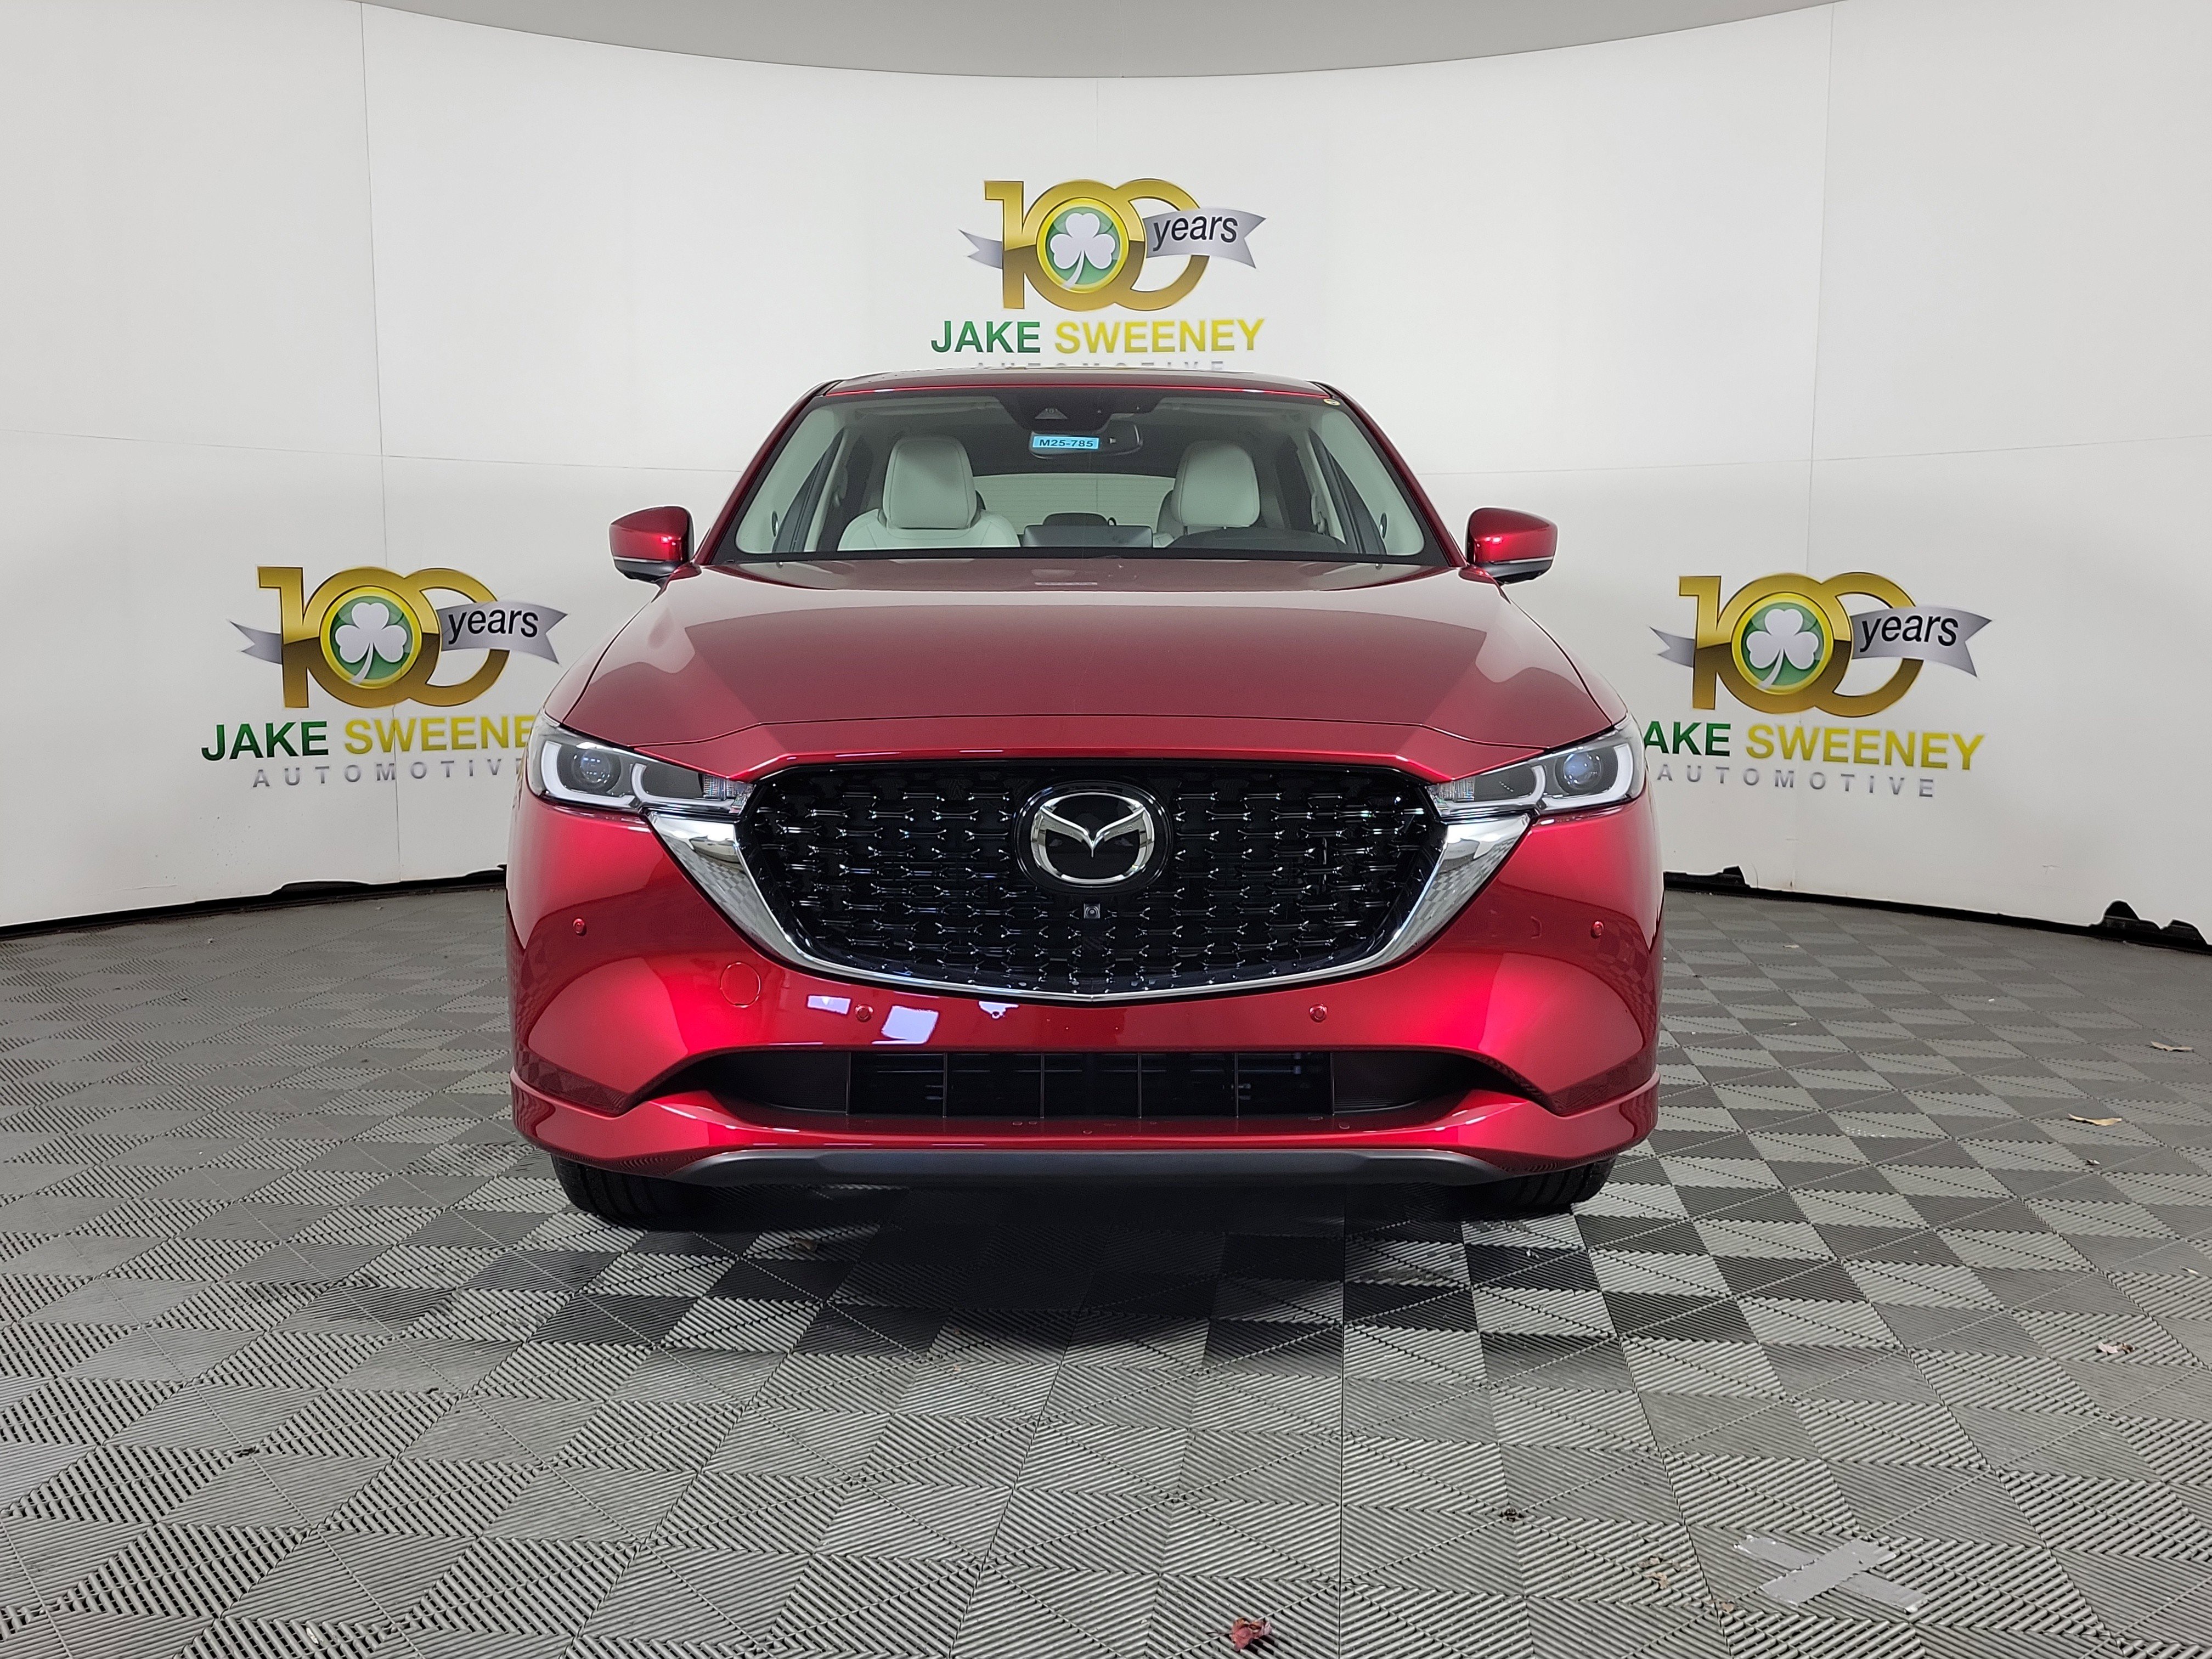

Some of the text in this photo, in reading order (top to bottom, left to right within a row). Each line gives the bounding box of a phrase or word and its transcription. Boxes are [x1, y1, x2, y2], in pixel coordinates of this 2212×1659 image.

[984, 178, 1238, 312] 100 years
[931, 318, 1265, 353] JAKE SWEENEY
[257, 566, 539, 708] 100 years
[1679, 572, 1960, 717] 100 years
[201, 715, 534, 761] JAKE SWEENE
[1644, 720, 1984, 770] AKE SWEENEY
[1657, 764, 1934, 797] AUTOMOTIVE
